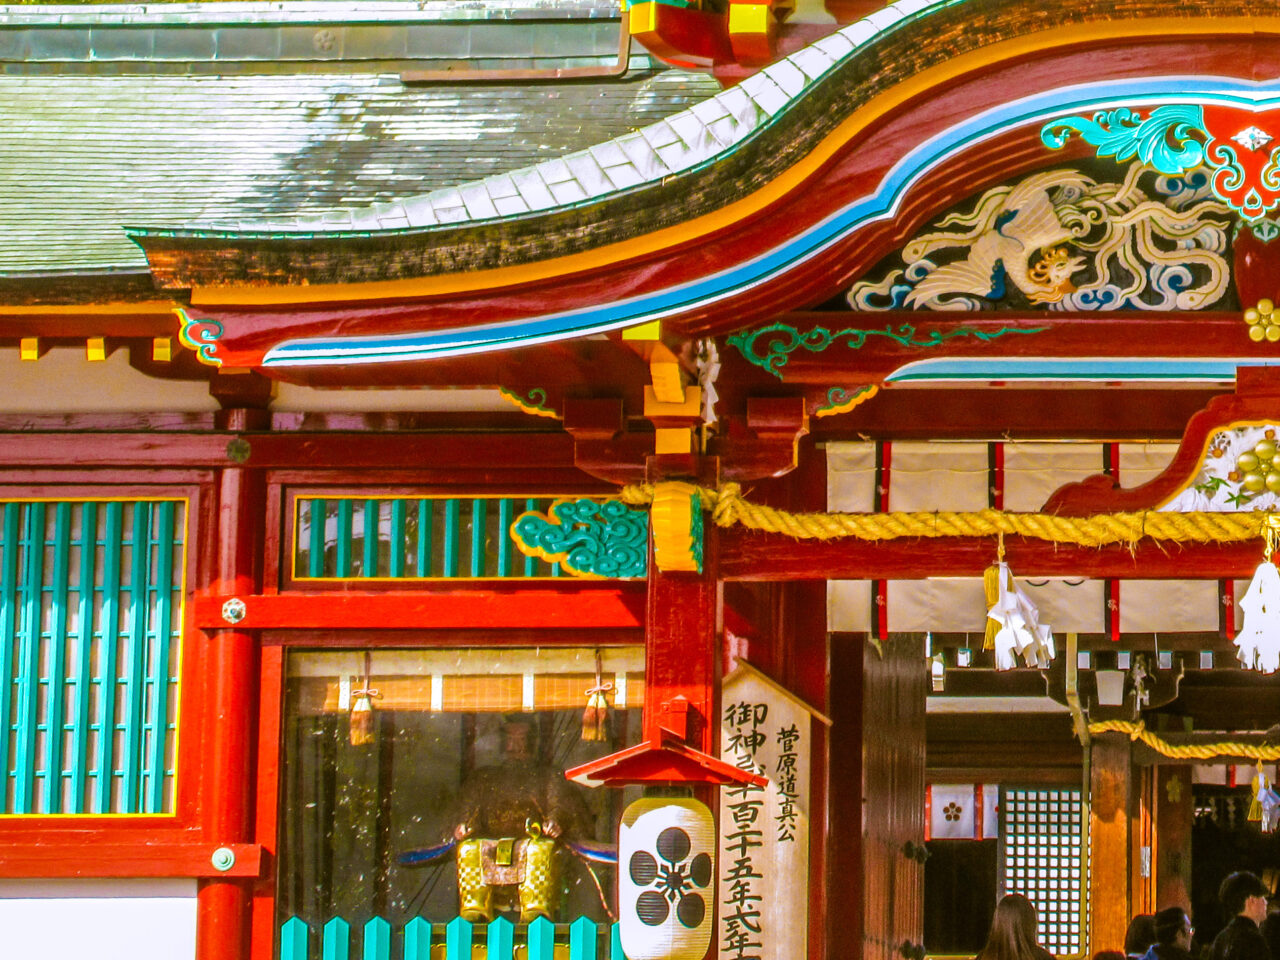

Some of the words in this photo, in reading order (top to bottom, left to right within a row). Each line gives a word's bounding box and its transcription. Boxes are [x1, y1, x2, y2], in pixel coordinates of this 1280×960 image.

[775, 724, 800, 842] 菅原道真公
